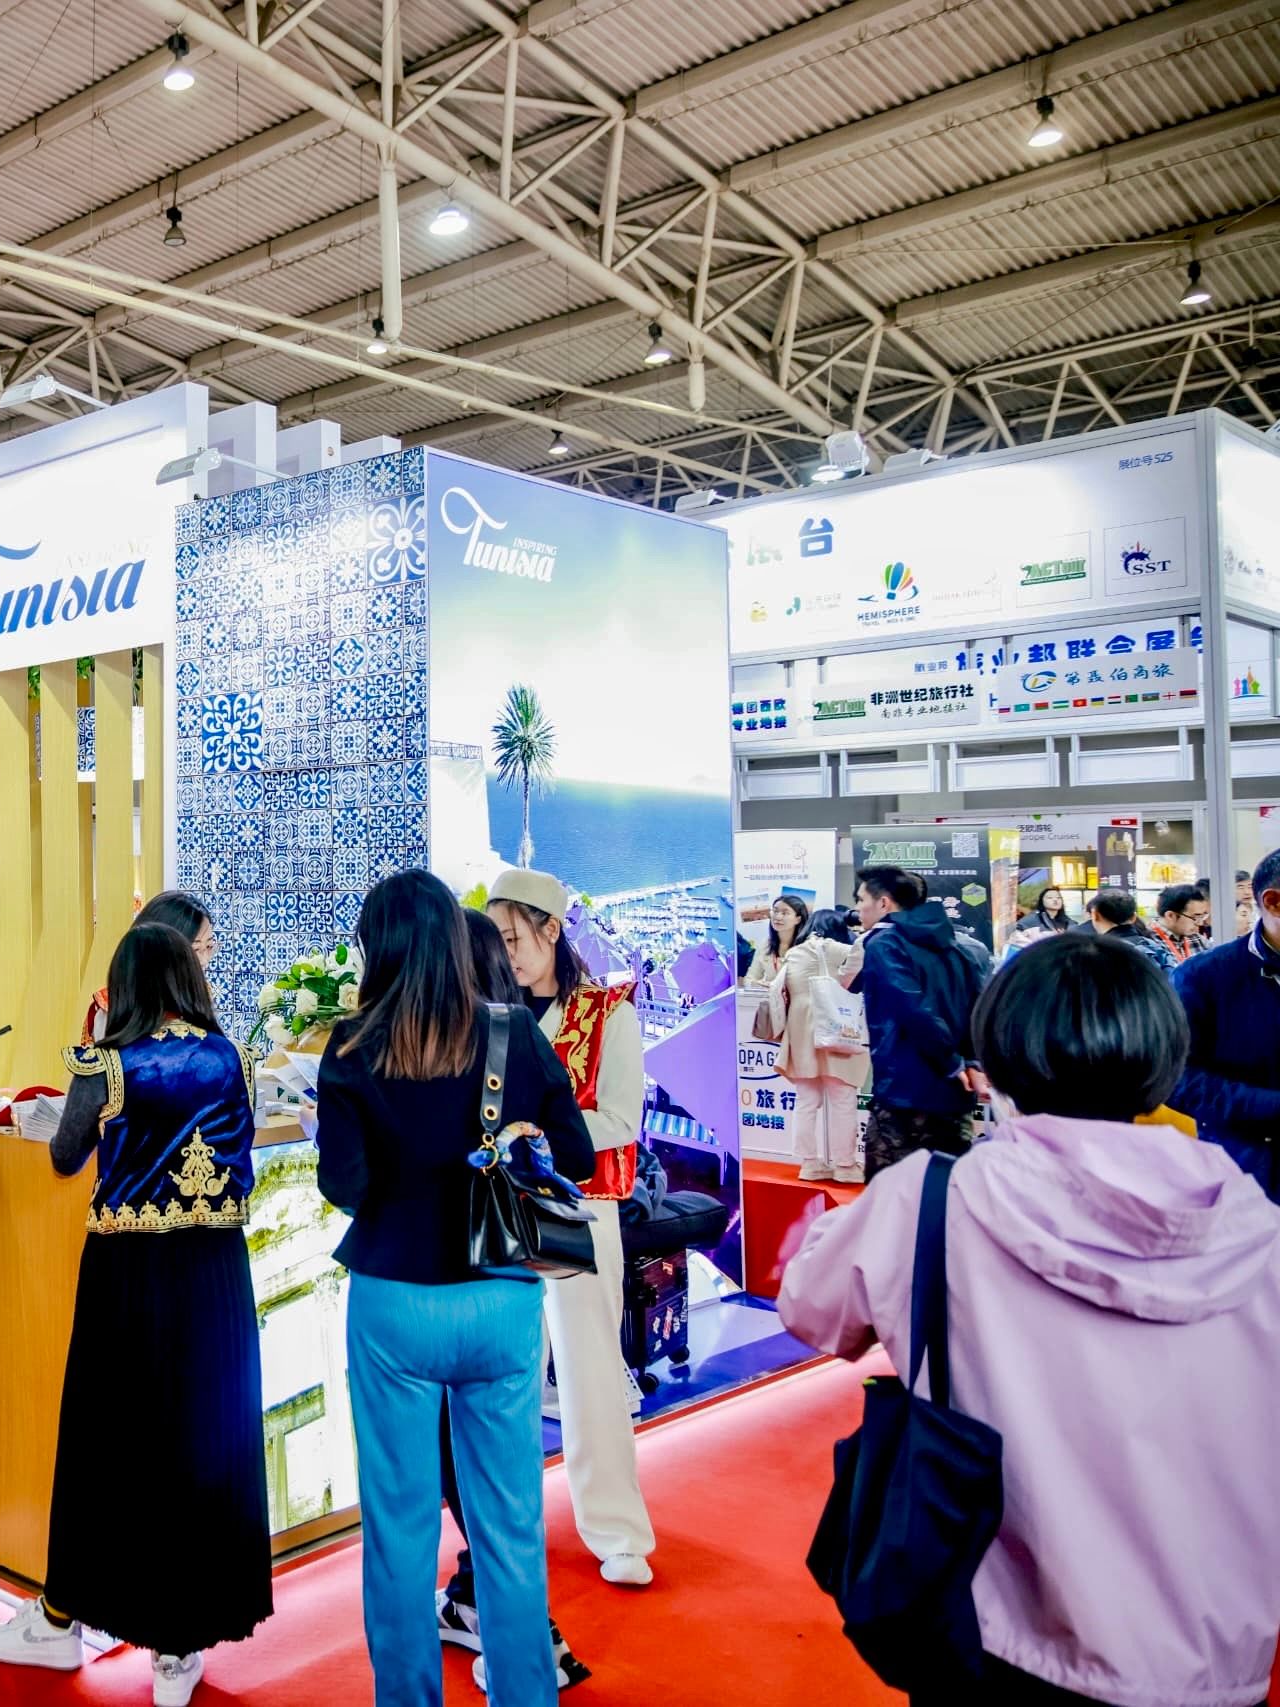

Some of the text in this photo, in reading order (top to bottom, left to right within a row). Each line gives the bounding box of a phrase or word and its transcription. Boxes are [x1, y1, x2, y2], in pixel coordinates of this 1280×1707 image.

[440, 486, 556, 583] Tunisia
[1132, 560, 1172, 576] SST
[857, 605, 921, 622] HEMISPHERE
[870, 683, 975, 706] 非洲世纪旅行社
[731, 716, 787, 731] 专业地接
[1019, 833, 1046, 841] urope
[766, 1051, 778, 1067] G
[756, 1088, 797, 1111] 旅行
[742, 1113, 785, 1130] 团地接
